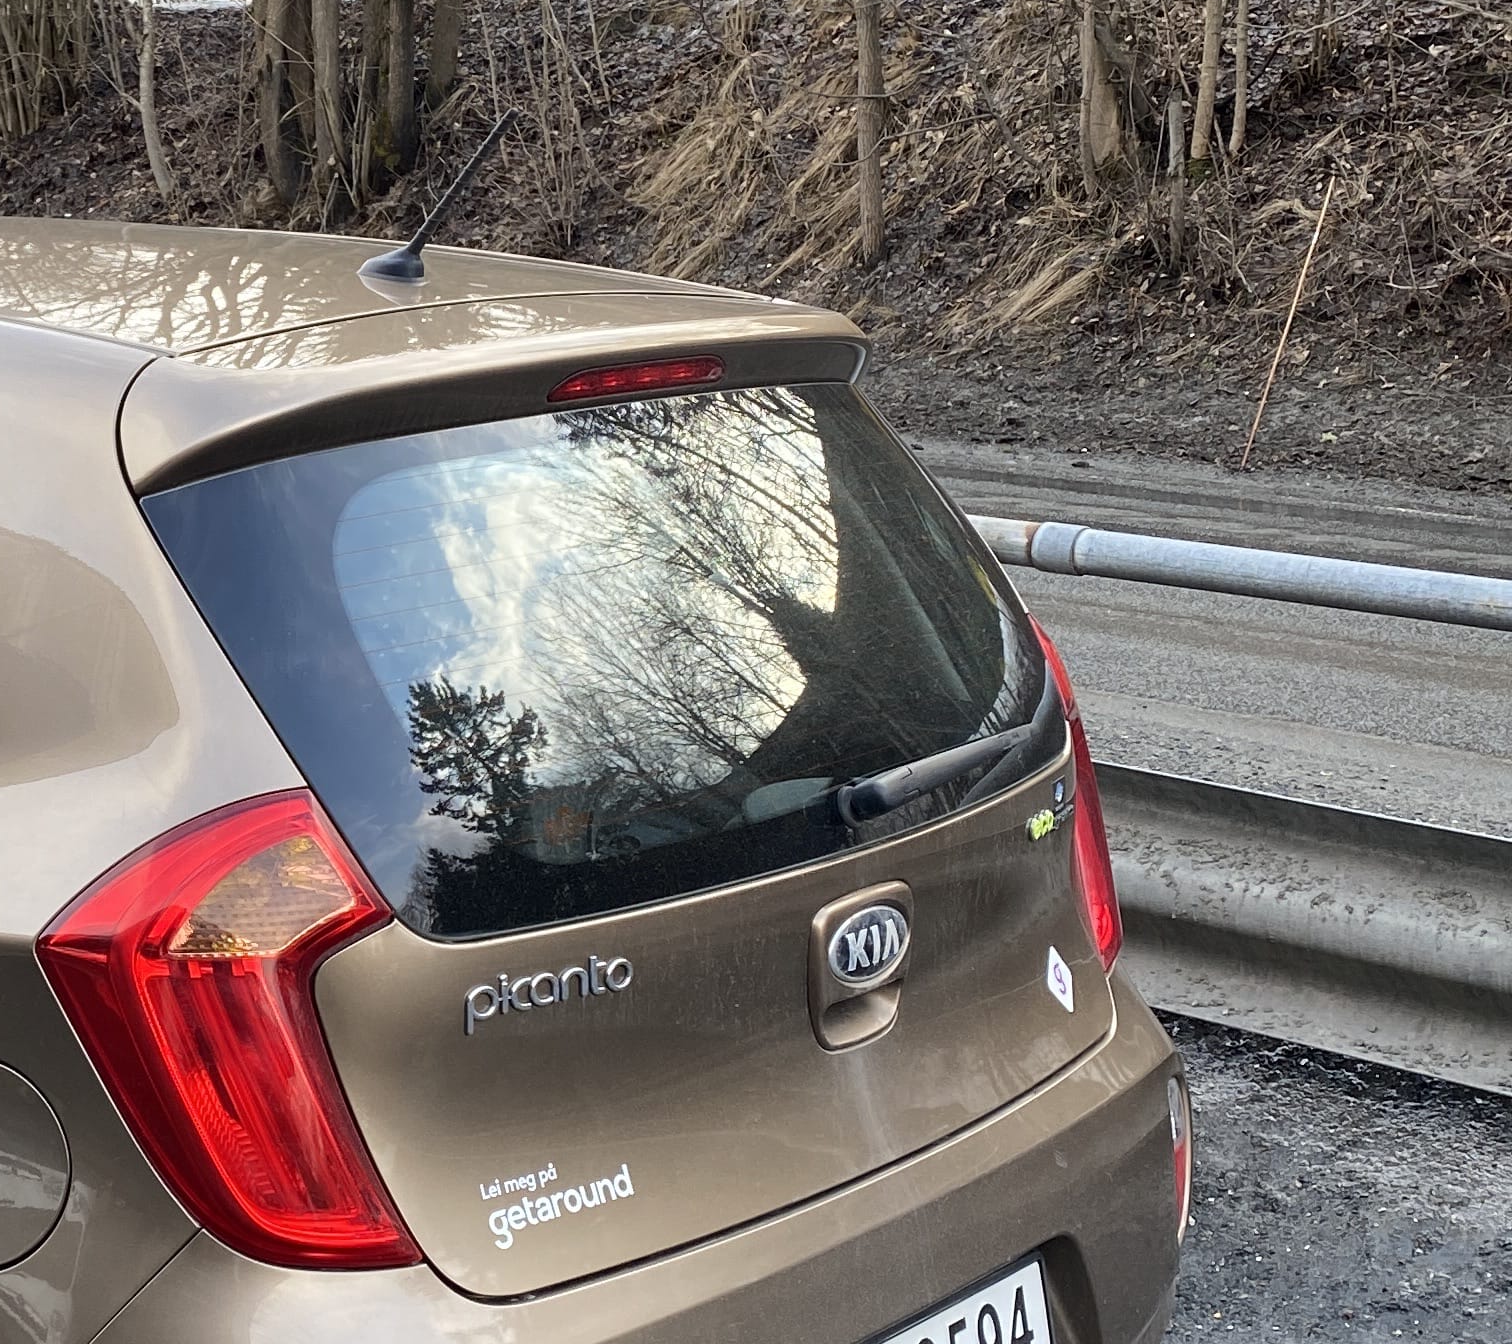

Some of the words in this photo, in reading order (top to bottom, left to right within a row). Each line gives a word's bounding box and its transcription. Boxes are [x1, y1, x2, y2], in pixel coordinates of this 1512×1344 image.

[845, 918, 901, 972] KIA
[463, 955, 634, 1036] picanto
[479, 1178, 502, 1200] Lei
[504, 1173, 537, 1194] meg
[538, 1162, 558, 1188] på
[488, 1163, 635, 1250] getaround
